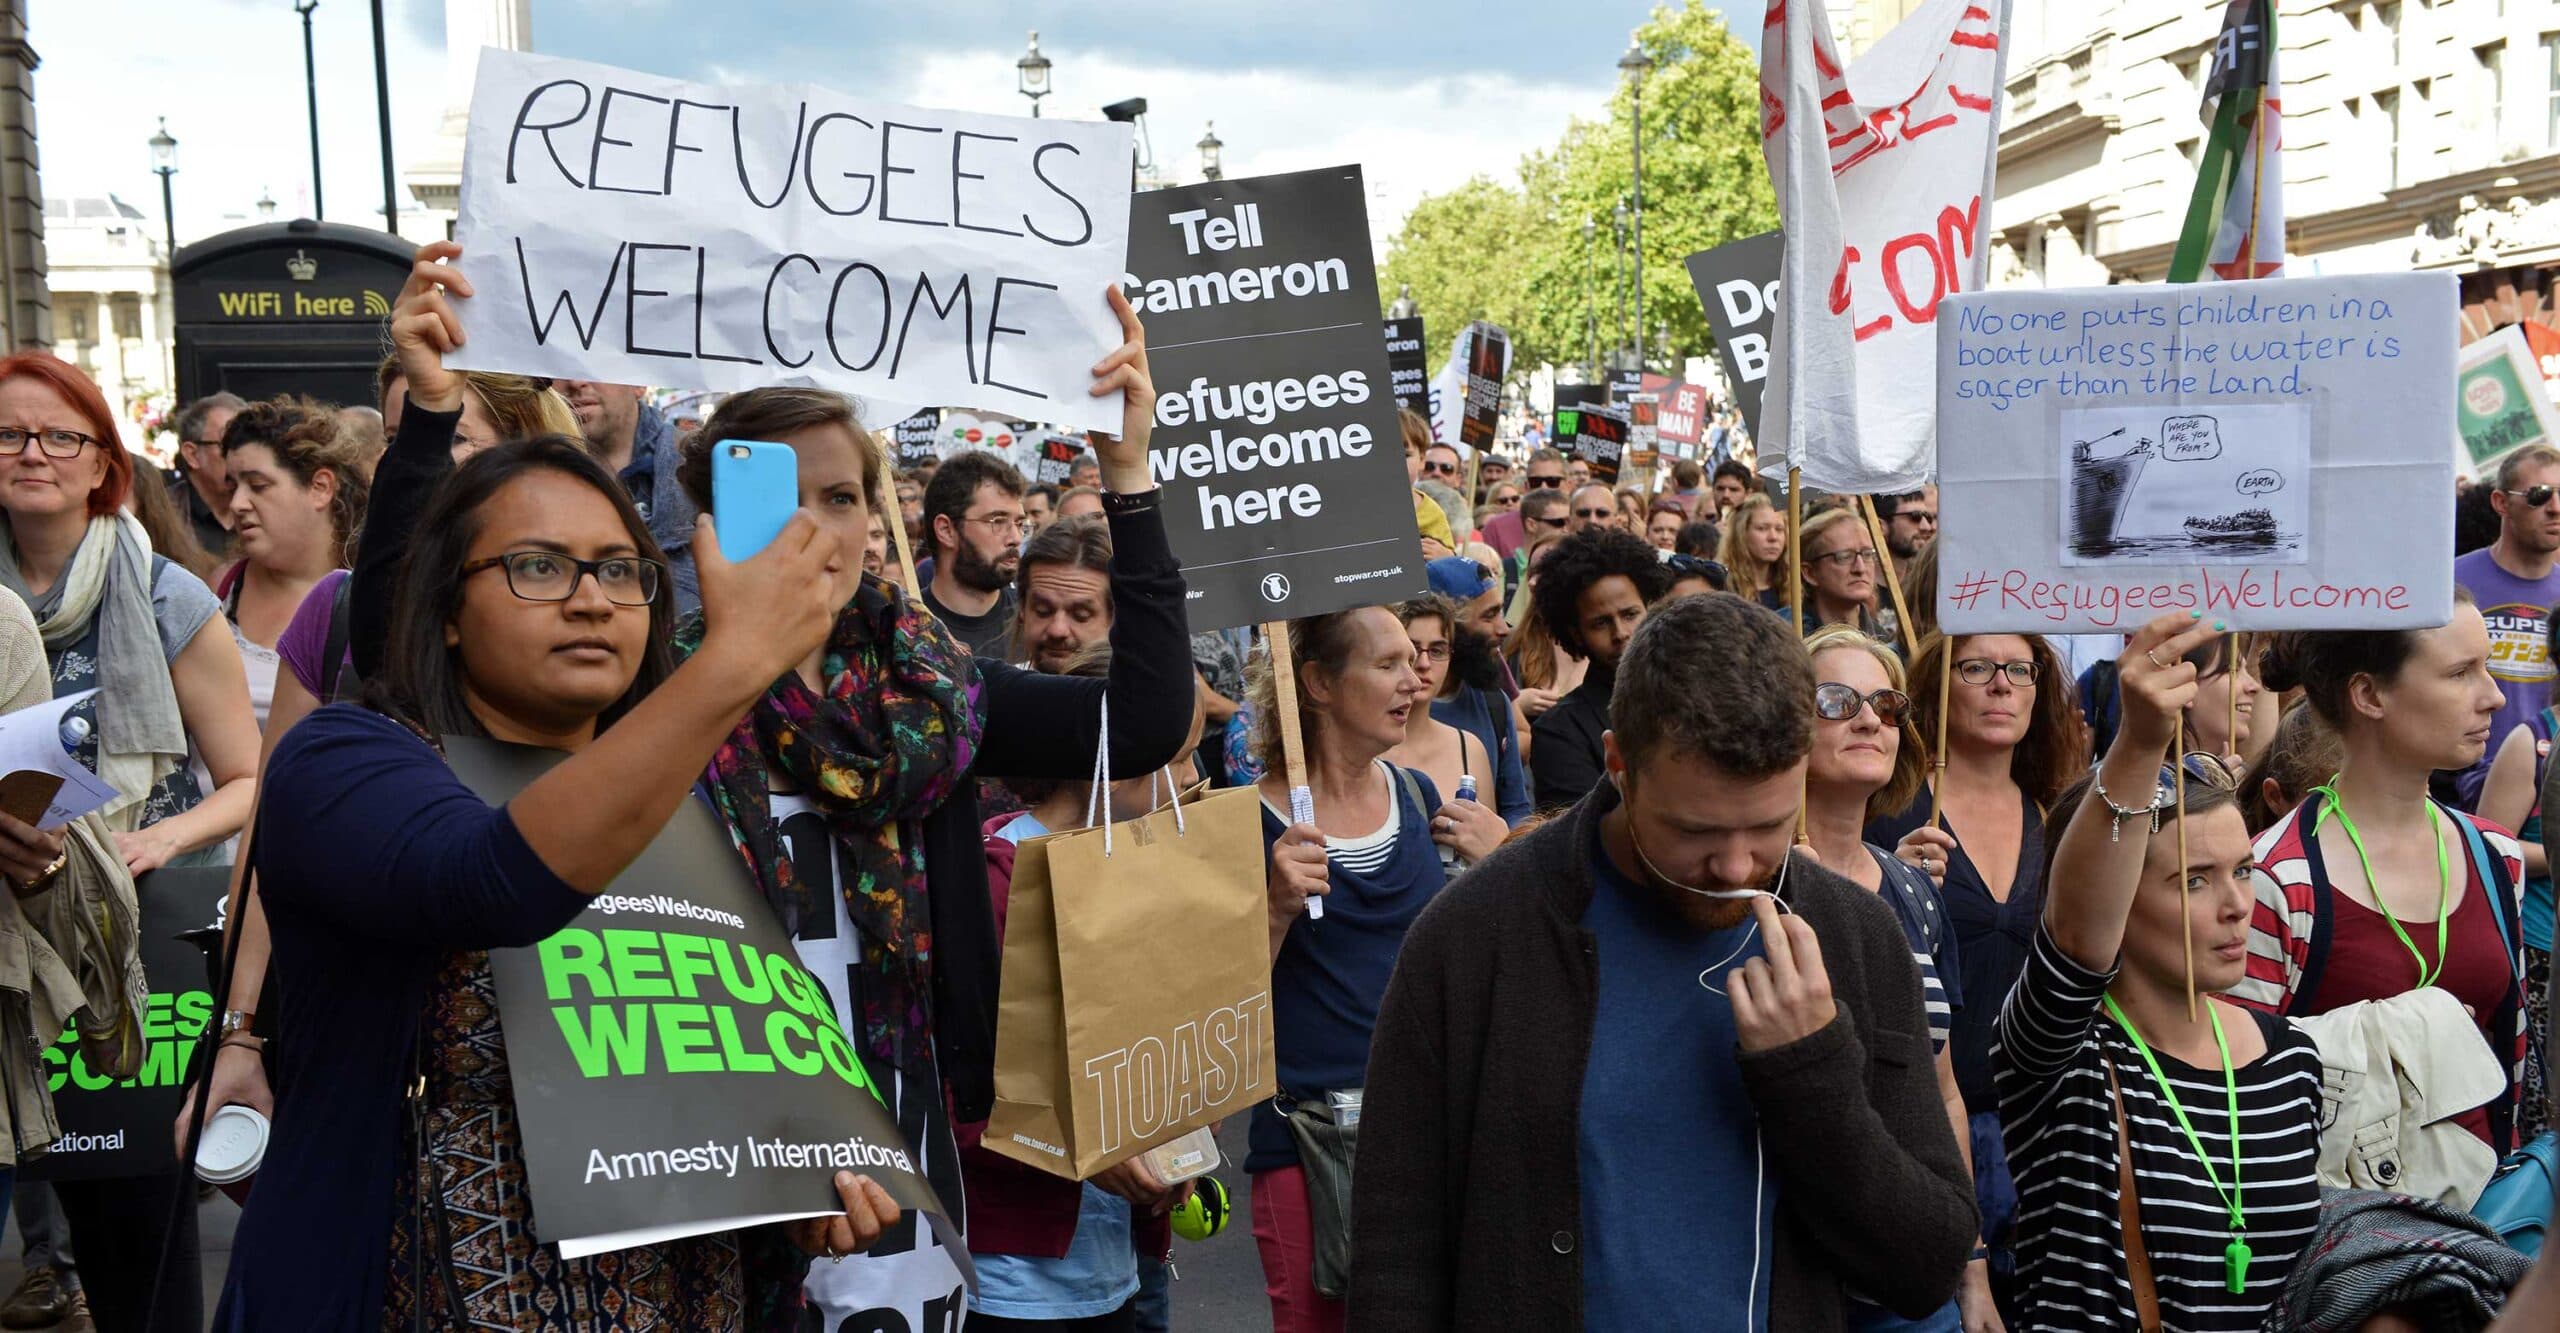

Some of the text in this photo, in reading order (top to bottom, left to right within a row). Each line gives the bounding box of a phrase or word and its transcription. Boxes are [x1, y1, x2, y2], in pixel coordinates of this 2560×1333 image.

[507, 79, 1092, 247] REFUGEES
[1169, 202, 1264, 255] Tell
[219, 292, 355, 316] WiFi here
[514, 236, 1060, 398] WELCOME
[1959, 294, 2393, 346] No one puts children in a
[1958, 330, 2401, 367] boat unless the water is
[1151, 369, 1371, 428] efugees
[1677, 389, 1698, 413] BE
[2056, 371, 2128, 396] than
[2140, 368, 2197, 395] the
[2167, 430, 2209, 443] ARE YOU
[2168, 419, 2200, 432] WHERE
[2243, 476, 2275, 489] EARTH
[1197, 483, 1322, 530] here
[1334, 565, 1404, 584] stopwar.org.uk
[1085, 991, 1268, 1155] TOAST
[584, 1136, 916, 1185] Amnesty International
